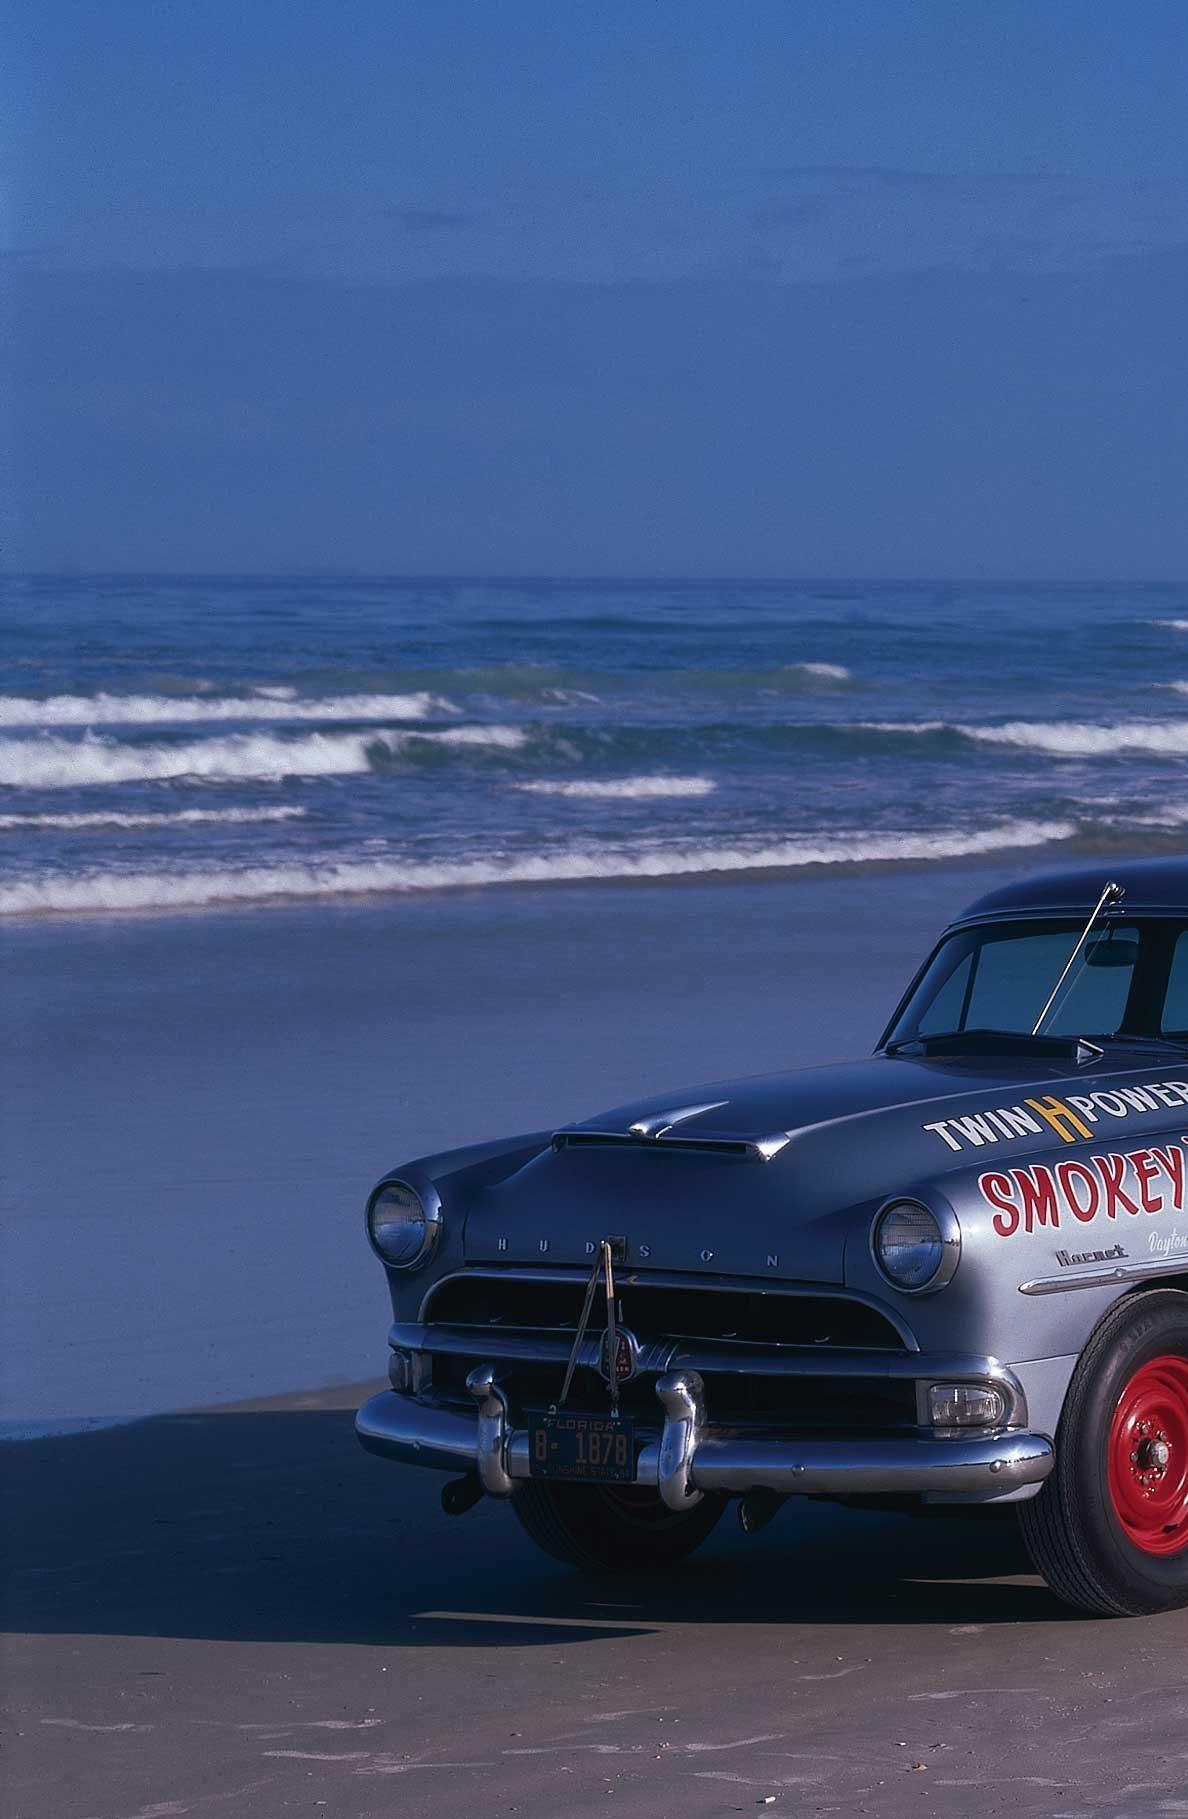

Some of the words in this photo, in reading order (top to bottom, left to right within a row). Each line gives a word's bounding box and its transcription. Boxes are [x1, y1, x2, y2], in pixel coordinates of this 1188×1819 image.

[922, 1106, 1040, 1152] TWIN
[1025, 1095, 1094, 1144] H
[497, 1238, 779, 1268] HUDSON
